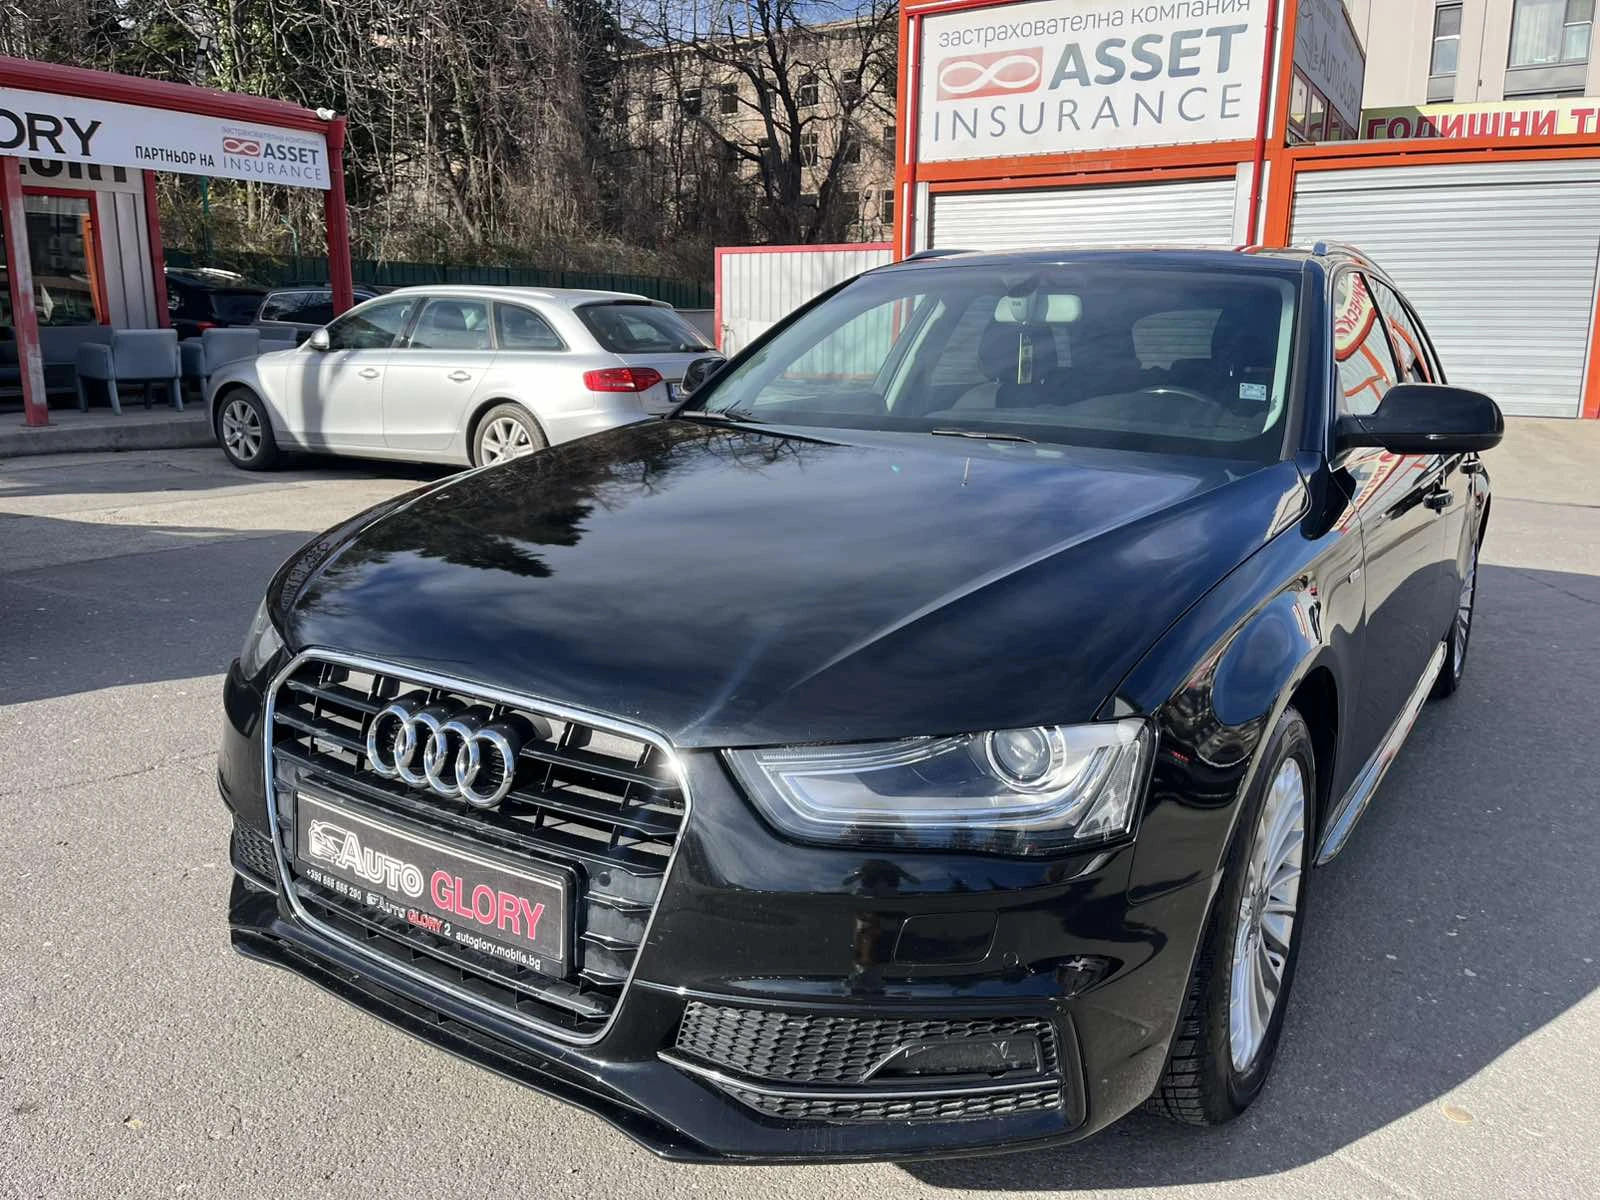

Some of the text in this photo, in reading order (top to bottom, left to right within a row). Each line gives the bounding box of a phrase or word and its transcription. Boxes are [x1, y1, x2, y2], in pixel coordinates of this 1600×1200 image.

[938, 0, 1250, 47] застрахователна компания
[1048, 24, 1248, 90] ASSET
[934, 83, 1243, 142] INSURANCE
[135, 145, 215, 168] ПАРТНЬОР НА
[223, 156, 321, 181] INSURANCE
[263, 142, 319, 165] ASSET
[430, 870, 545, 940] GLORY
[444, 923, 451, 937] 2
